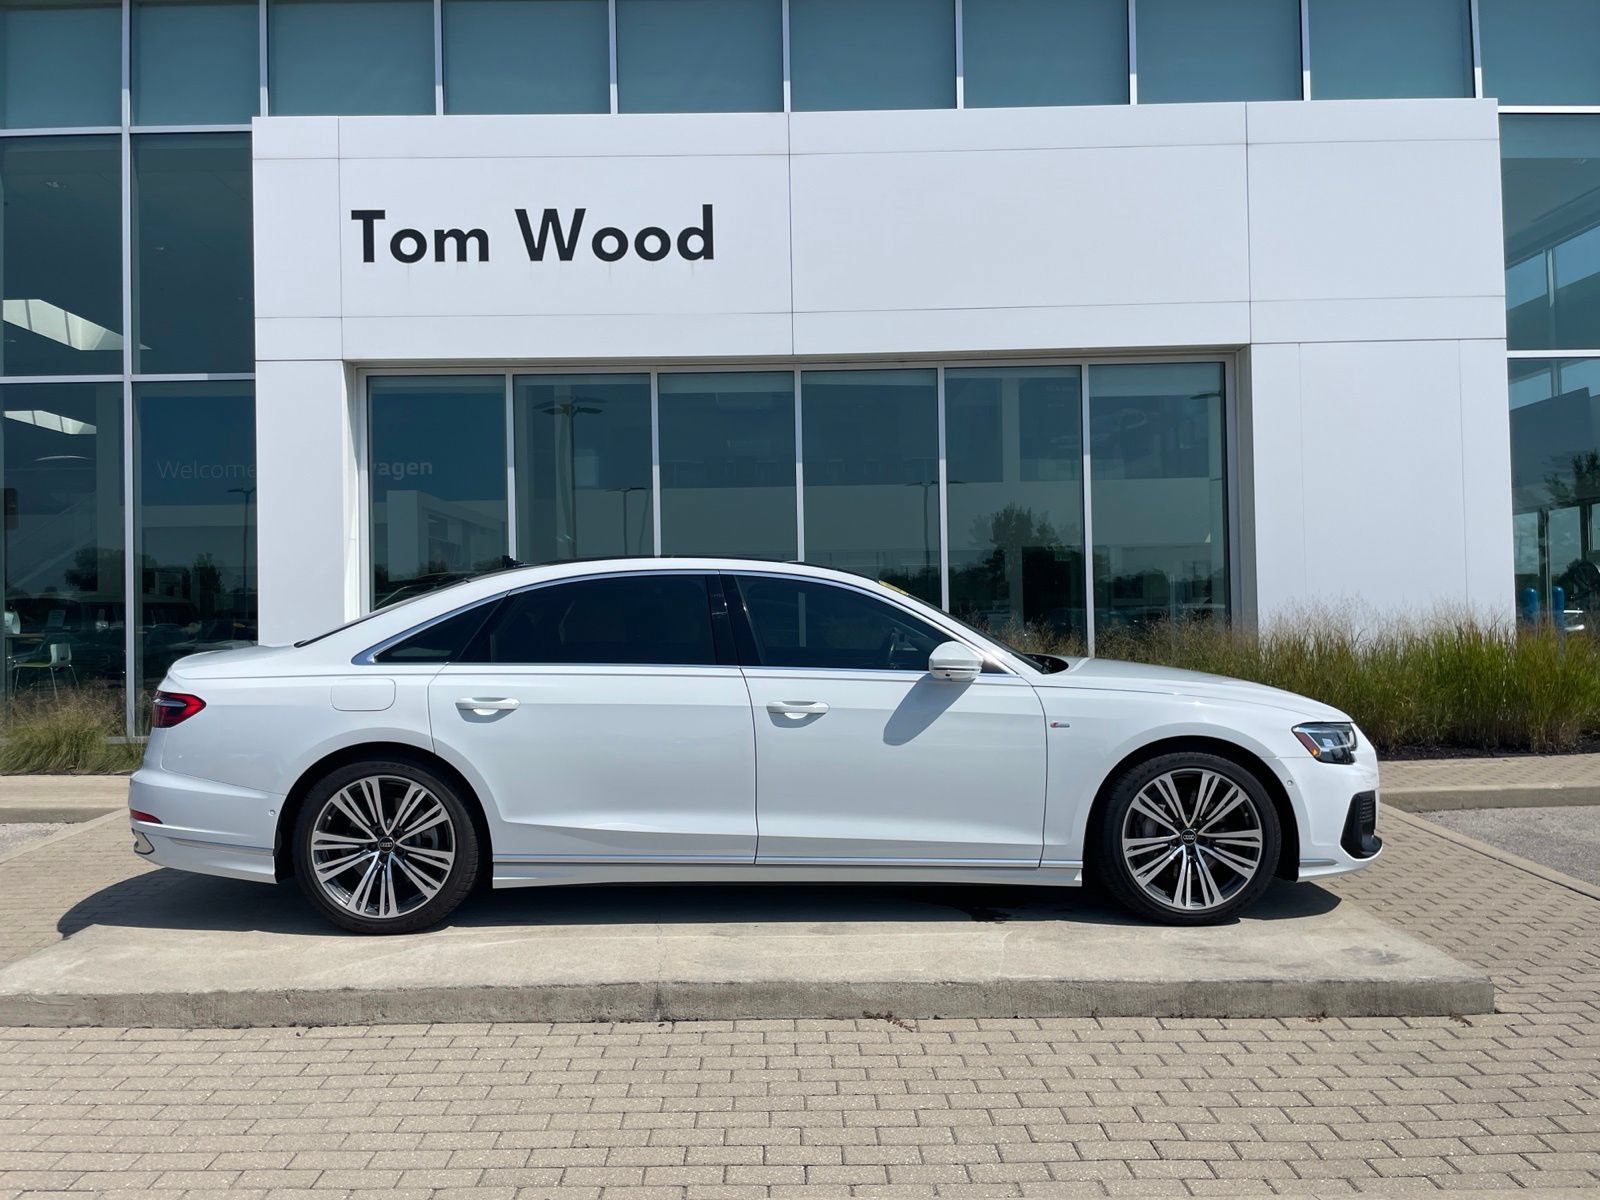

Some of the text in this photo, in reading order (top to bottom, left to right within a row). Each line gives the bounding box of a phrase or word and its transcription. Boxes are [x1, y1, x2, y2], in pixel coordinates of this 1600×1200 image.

[351, 204, 714, 263] Tom Wood
[156, 458, 256, 479] Welcome
